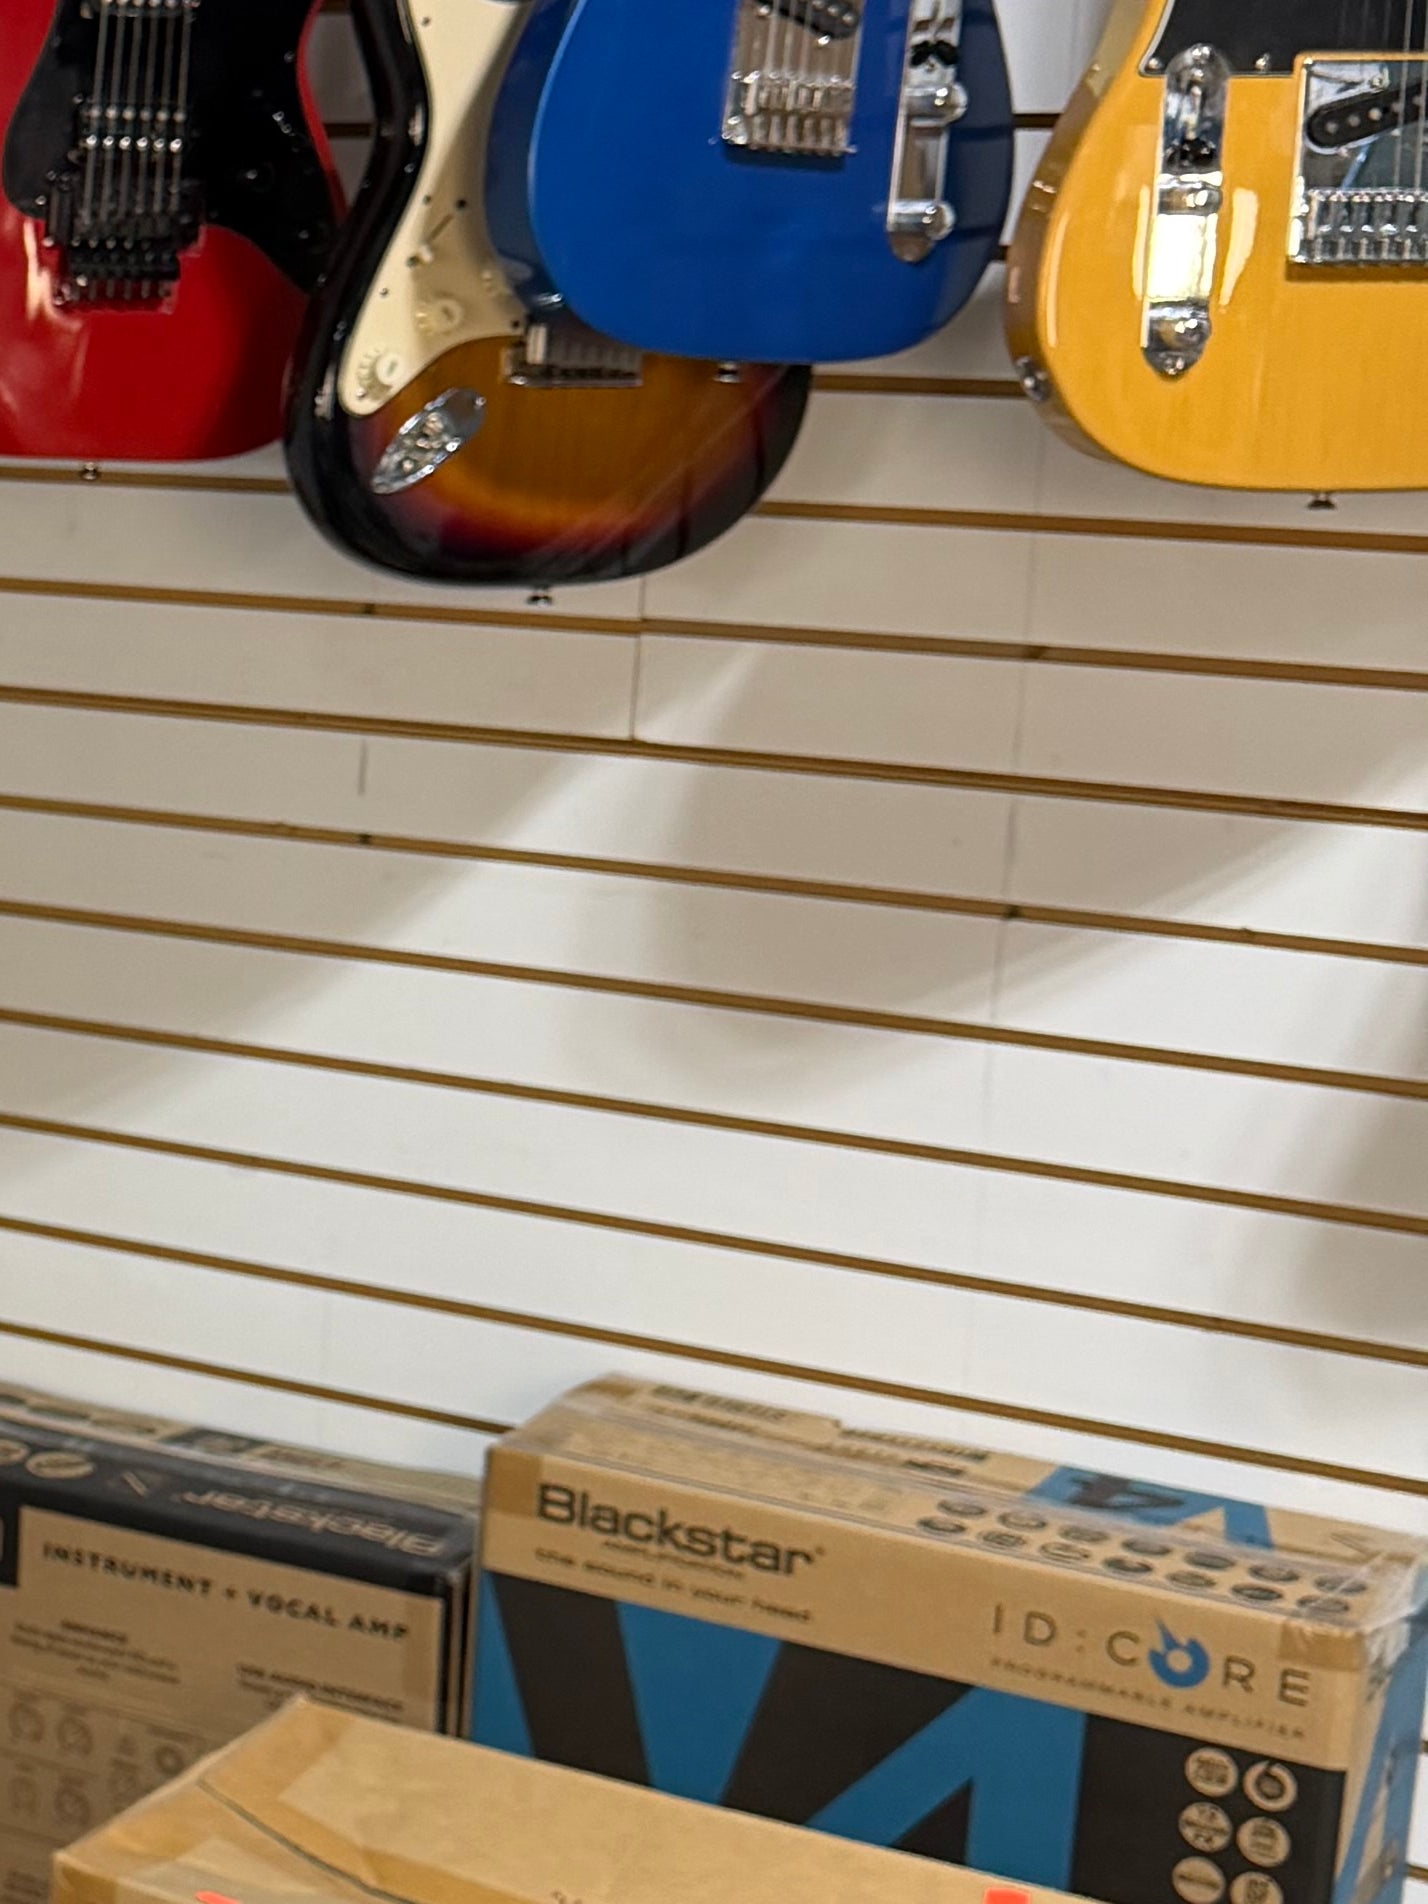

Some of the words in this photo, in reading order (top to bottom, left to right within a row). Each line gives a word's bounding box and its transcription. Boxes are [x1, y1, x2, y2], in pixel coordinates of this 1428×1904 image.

[537, 1482, 816, 1575] Blackstar
[43, 1542, 213, 1597] INSTRUMENT
[247, 1590, 339, 1627] VOCAL
[348, 1614, 409, 1640] AMP
